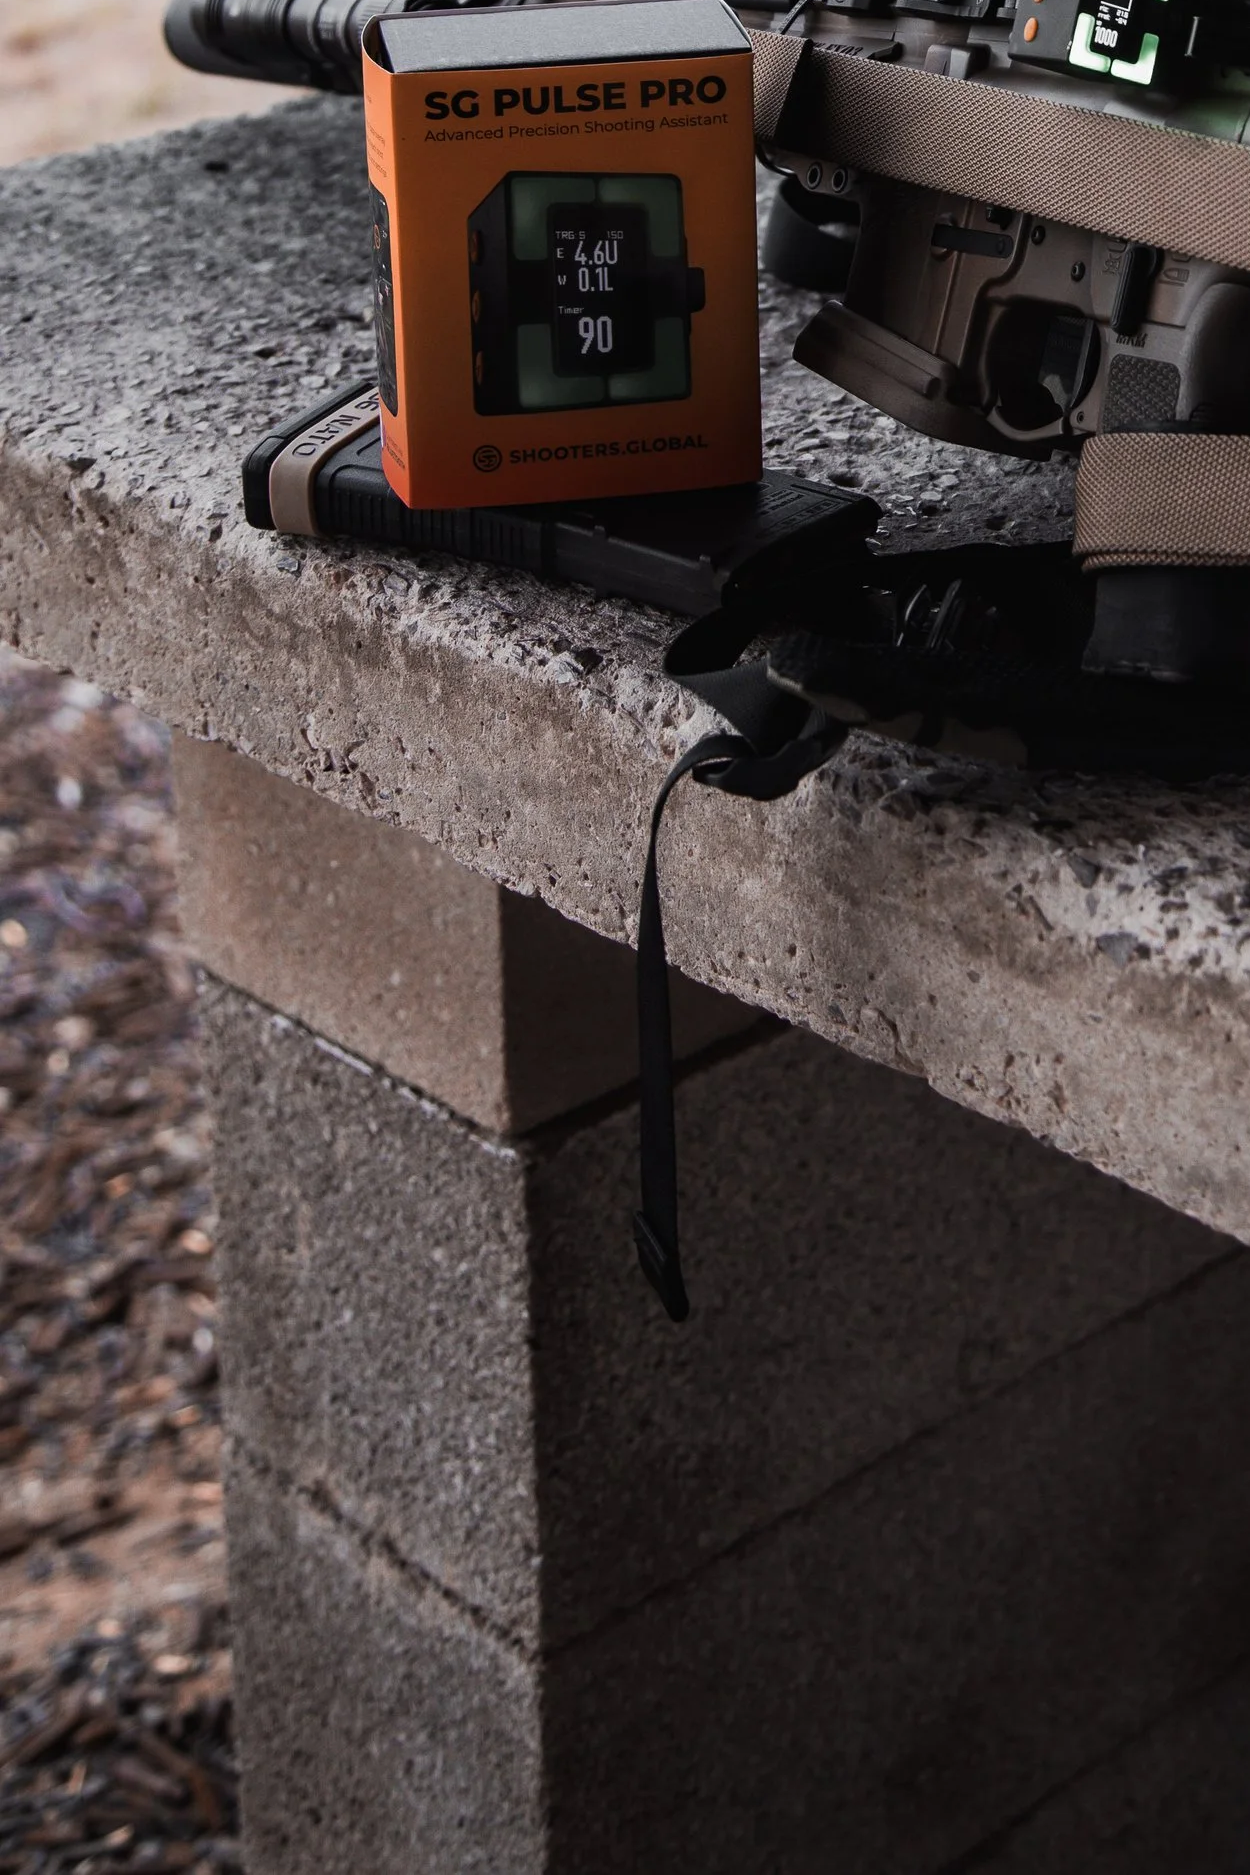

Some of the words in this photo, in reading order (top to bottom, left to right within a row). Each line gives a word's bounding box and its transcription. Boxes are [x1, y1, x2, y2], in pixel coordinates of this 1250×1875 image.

[1094, 26, 1119, 48] 1000
[424, 90, 480, 121] SG
[493, 82, 627, 117] PULSE
[640, 75, 727, 109] PRO
[424, 128, 503, 143] Advanced
[509, 123, 580, 139] Precision
[584, 118, 655, 133] Shooting
[659, 113, 728, 129] Assistant
[556, 247, 565, 259] E
[574, 240, 618, 265] 4.6U
[557, 275, 567, 286] W
[578, 267, 614, 292] 0.1L
[558, 305, 584, 315] Timer
[578, 315, 613, 355] 90
[292, 414, 361, 458] NATO
[509, 435, 708, 464] SHOOTERS.GLOBAL
